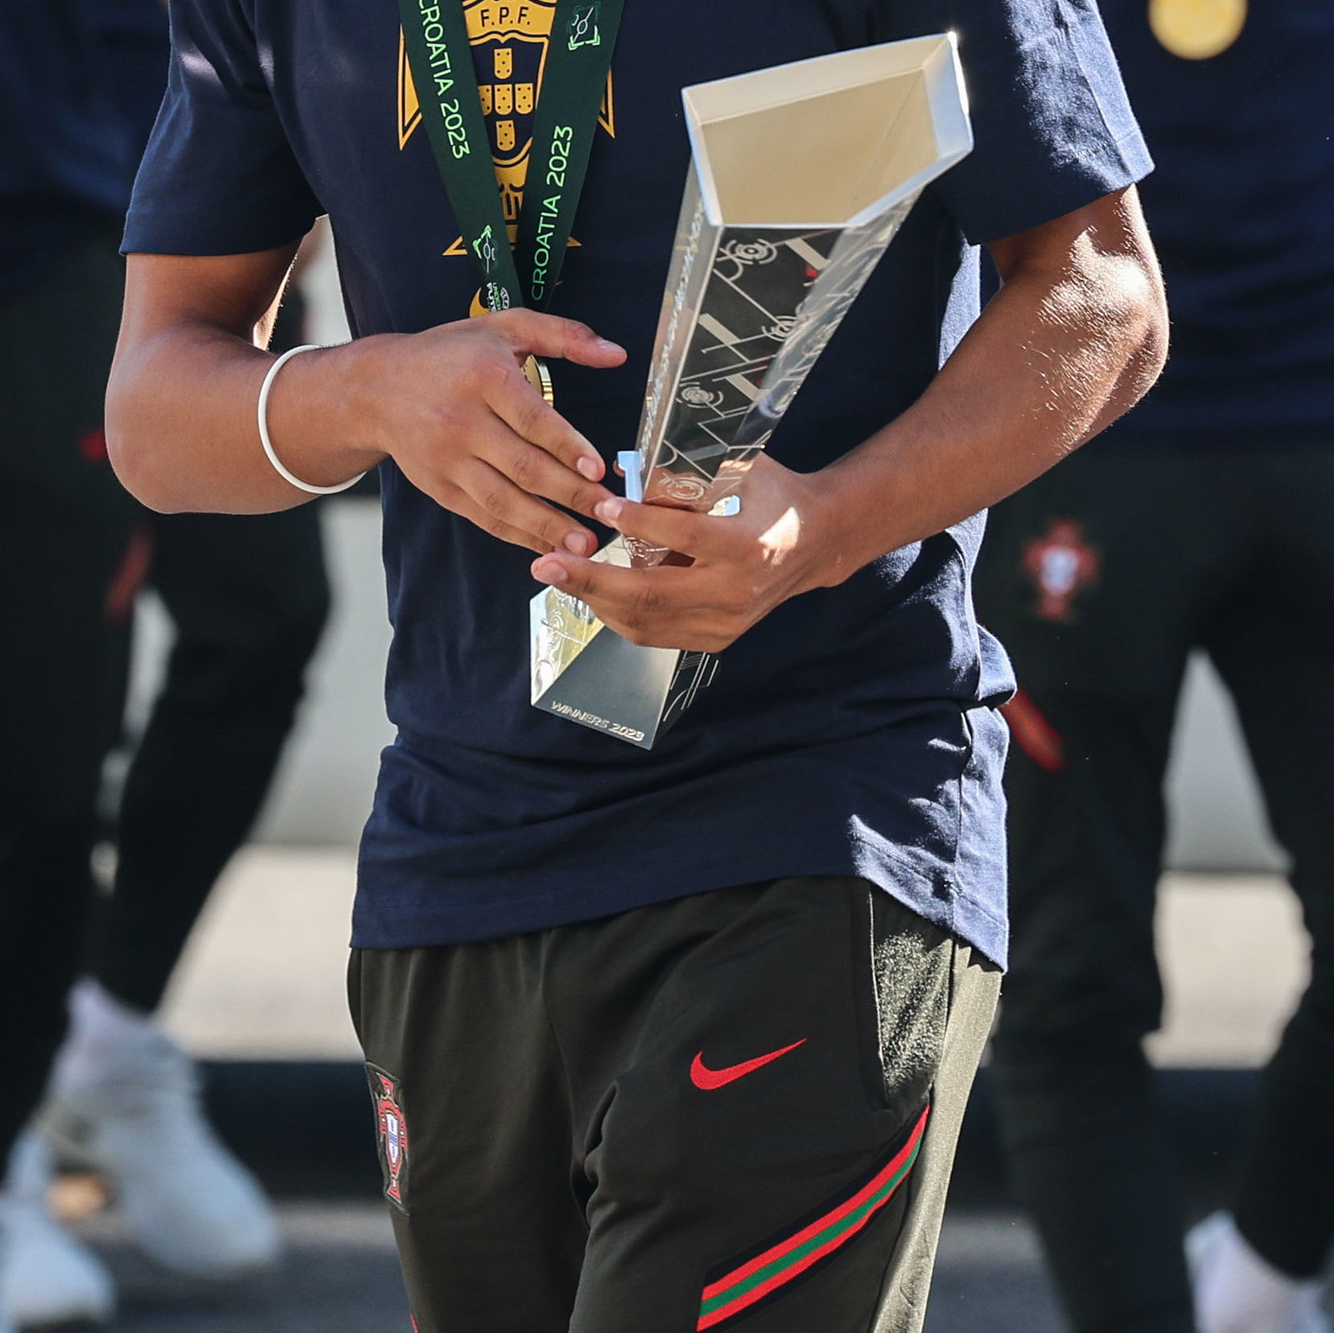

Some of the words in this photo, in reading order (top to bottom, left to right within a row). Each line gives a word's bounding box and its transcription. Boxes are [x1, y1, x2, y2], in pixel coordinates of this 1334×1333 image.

[480, 6, 531, 28] F.P.F.
[440, 99, 470, 159] 2023
[546, 125, 573, 188] 2023
[531, 194, 562, 301] CROATIA
[551, 700, 610, 729] WINNERS
[608, 722, 645, 742] 2023
